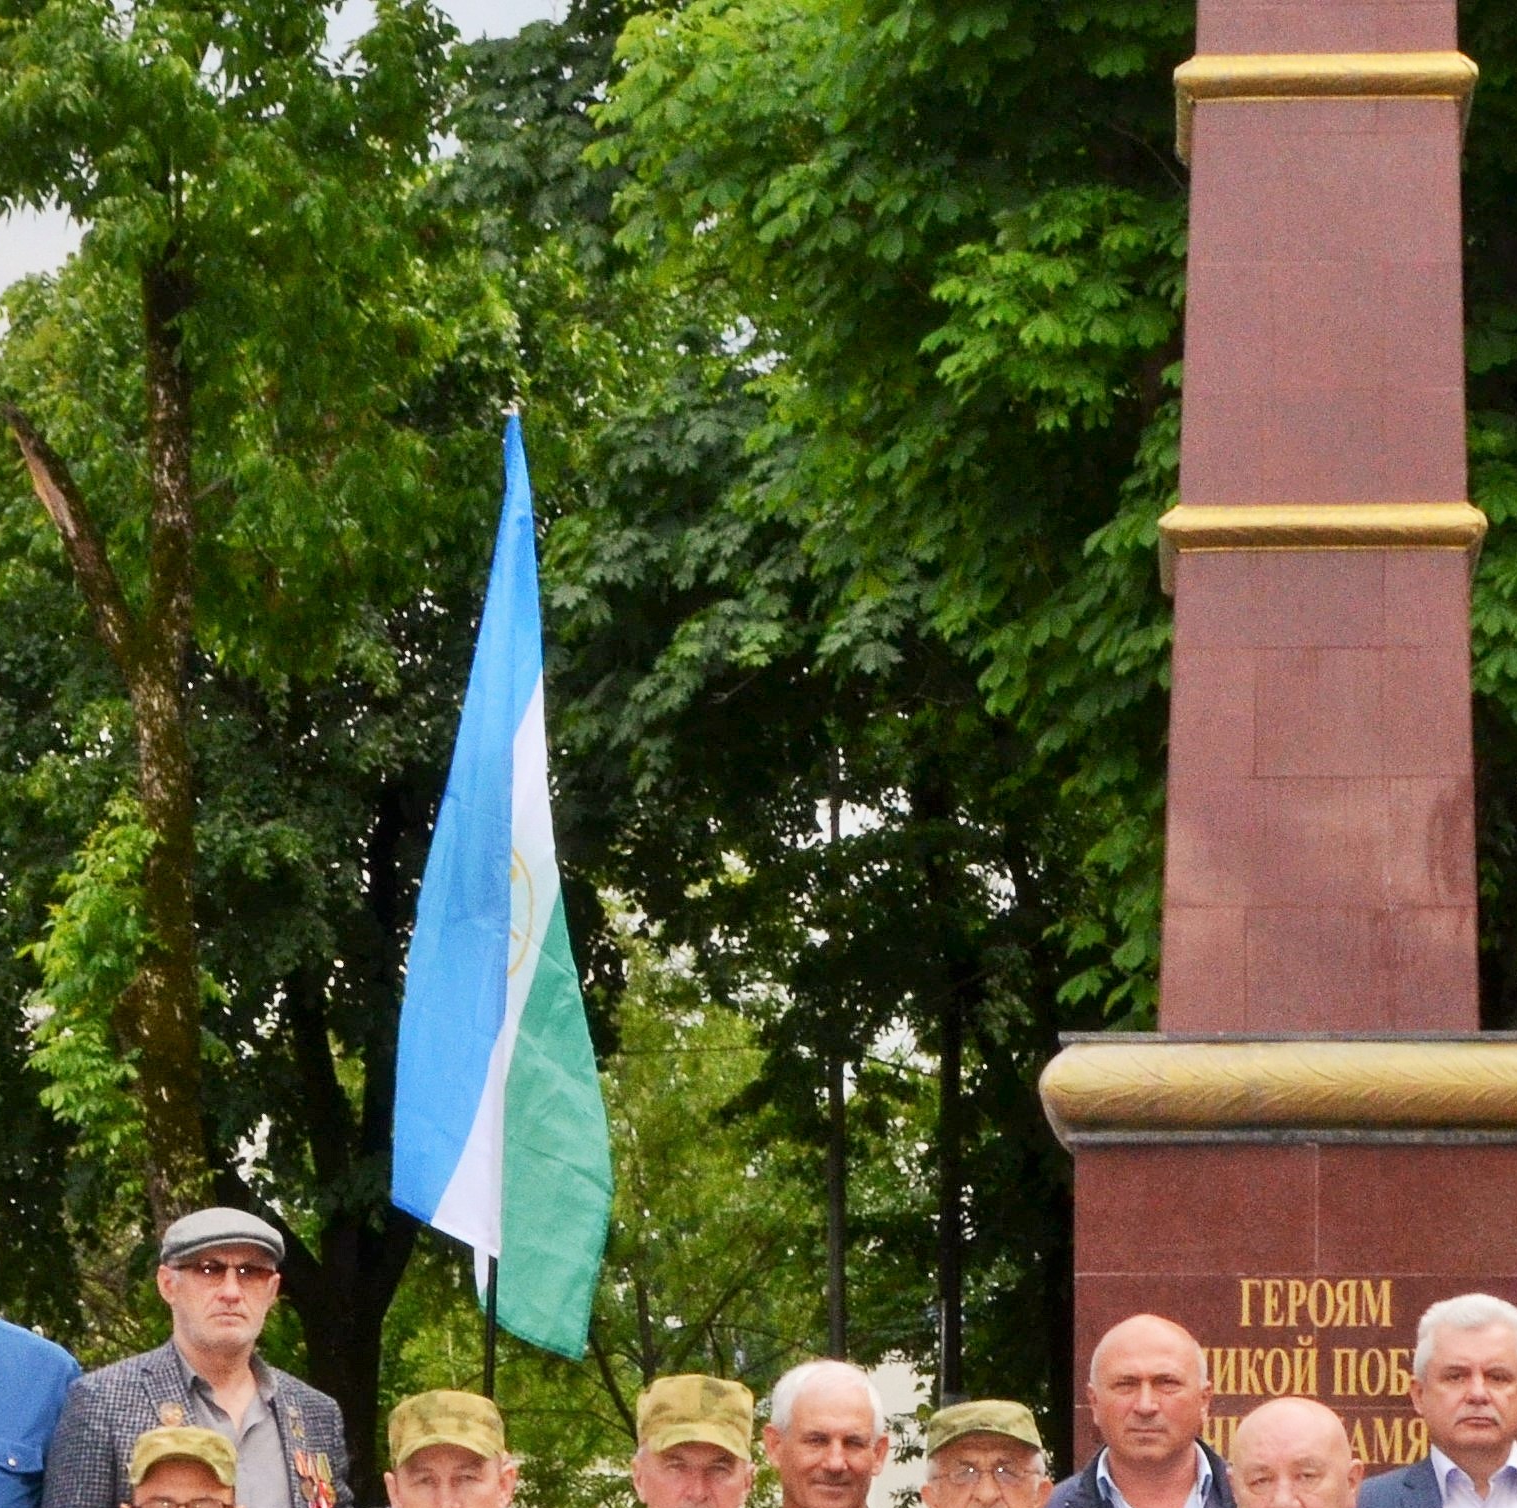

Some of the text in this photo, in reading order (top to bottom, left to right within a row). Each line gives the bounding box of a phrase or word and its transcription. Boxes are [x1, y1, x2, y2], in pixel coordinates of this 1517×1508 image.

[1239, 1279, 1392, 1328] ГЕРОЯМ
[1204, 1335, 1416, 1396] ИКОЙ ПОБ
[1350, 1416, 1429, 1465] АМЯ
